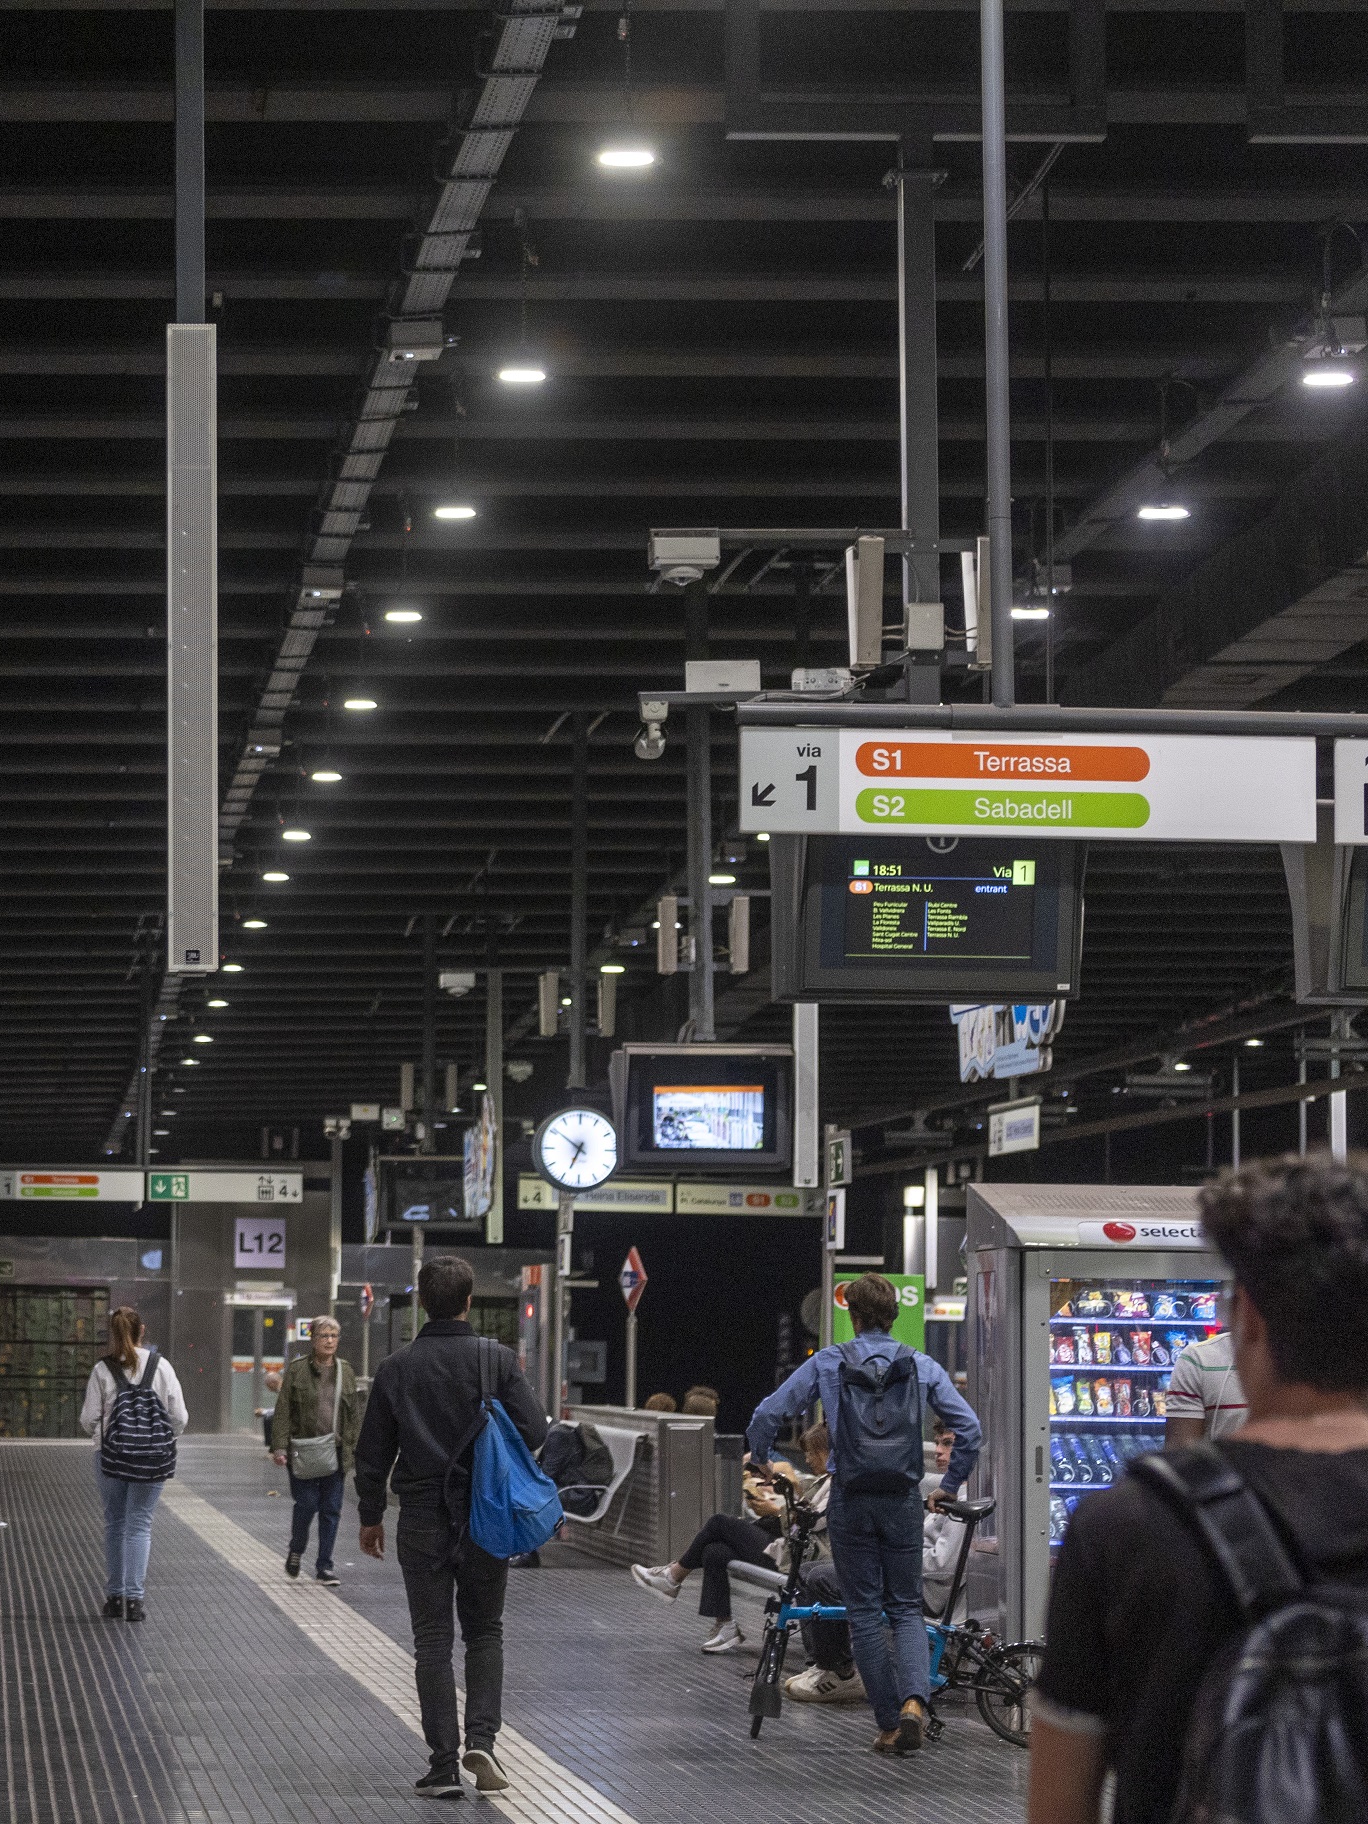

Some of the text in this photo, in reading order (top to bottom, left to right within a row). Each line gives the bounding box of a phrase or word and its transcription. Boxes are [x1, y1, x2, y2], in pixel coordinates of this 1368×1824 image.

[796, 743, 822, 758] via
[872, 748, 1072, 773] S1 Terrassa
[795, 765, 817, 811] 1
[872, 795, 1073, 819] S2 Sabadell
[873, 865, 902, 877] 18:51
[993, 865, 1028, 882] Via 1
[854, 882, 933, 893] S1 Terrassa N. U.
[975, 885, 1008, 894] entrant
[4, 1182, 11, 1195] 1
[279, 1184, 288, 1197] 4
[533, 1191, 542, 1203] 4
[239, 1232, 284, 1254] L12
